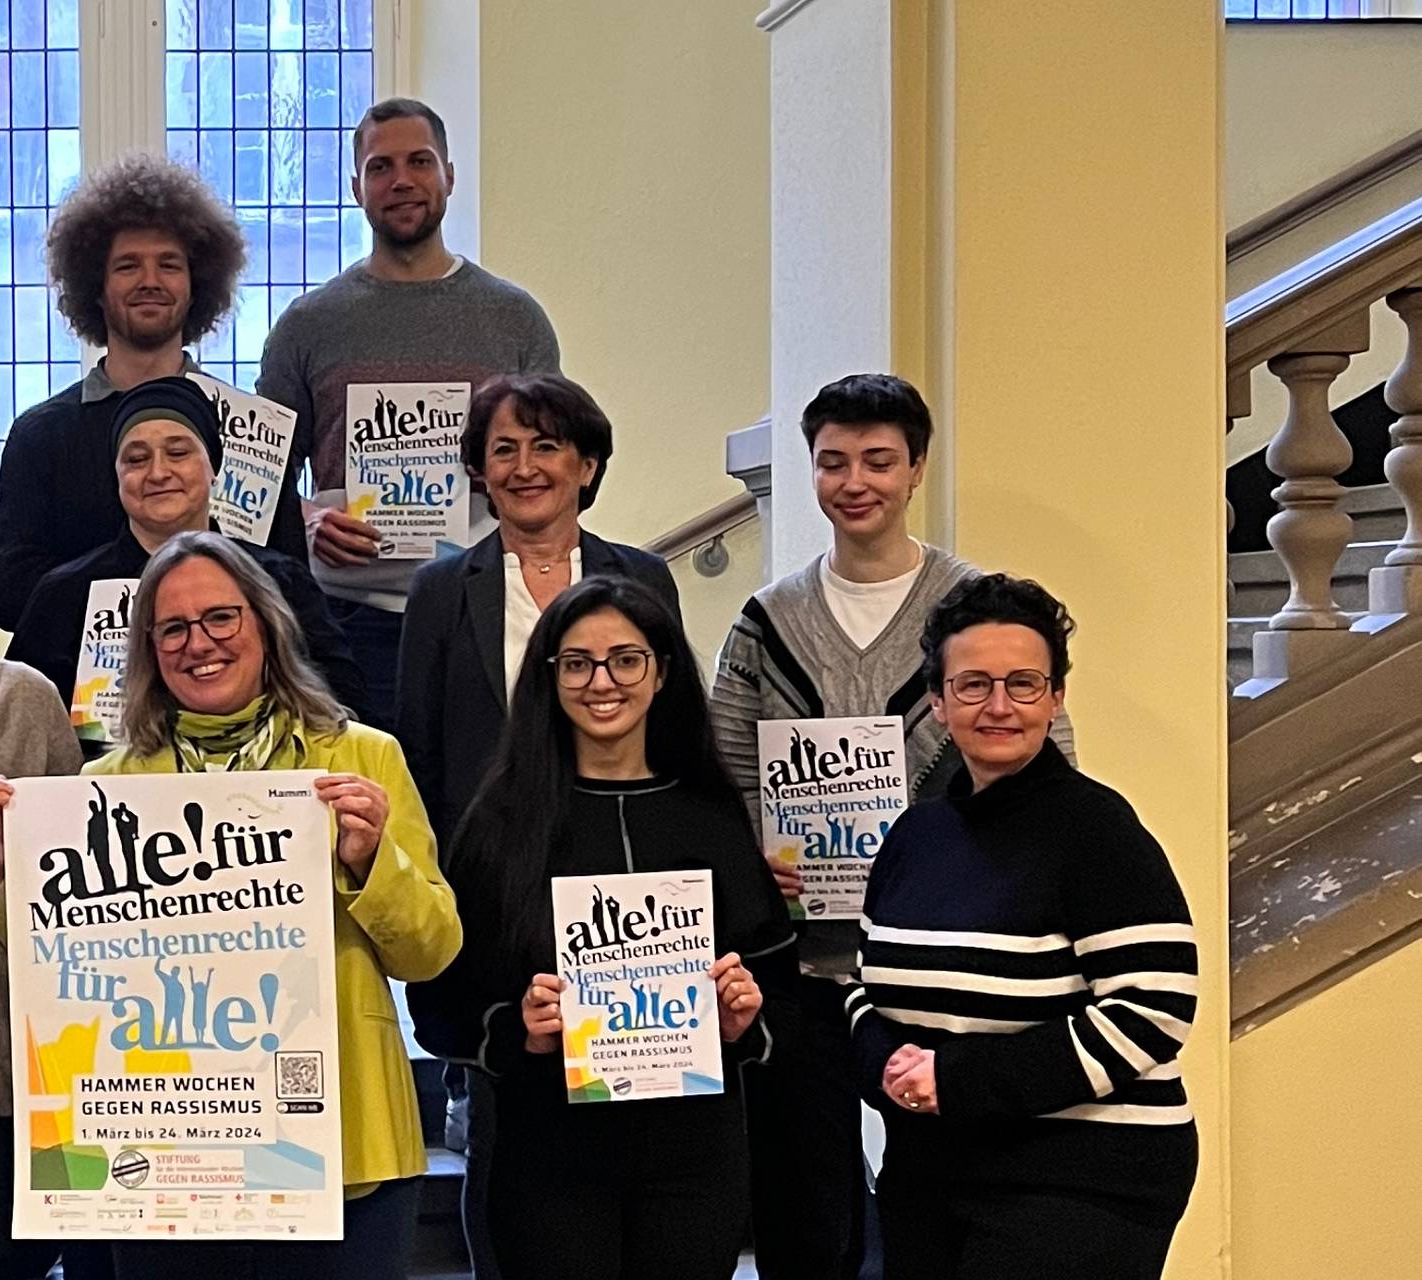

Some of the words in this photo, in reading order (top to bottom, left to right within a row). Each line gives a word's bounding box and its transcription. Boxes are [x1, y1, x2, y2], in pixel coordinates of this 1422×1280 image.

[354, 389, 428, 441] alle!
[428, 408, 463, 429] für
[257, 421, 286, 448] für
[350, 433, 460, 454] Menschenrecht
[350, 452, 460, 469] Menschenrecht
[359, 467, 389, 485] für
[380, 467, 454, 507] alle!
[767, 726, 855, 787] alle!
[855, 747, 895, 772] für
[763, 775, 901, 799] Menschenrechte
[764, 796, 903, 817] Menschenrechte
[778, 814, 812, 835] für
[39, 780, 215, 904] alle!
[212, 821, 293, 869] für
[30, 877, 305, 932] Menschenrechte
[566, 884, 661, 952] alle!
[661, 905, 704, 931] für
[31, 921, 306, 964] Menschenrechte
[561, 935, 710, 967] Menschenrechte
[564, 959, 711, 986] Menschenrechte
[57, 959, 127, 1000] für
[110, 955, 280, 1053] alle!
[578, 981, 616, 1006] für
[608, 981, 699, 1031] alle!
[592, 1036, 639, 1046] HAMMER
[643, 1033, 688, 1043] WOCHEN
[593, 1050, 627, 1059] GEGEN
[631, 1046, 692, 1056] RASSISMUS
[81, 1078, 166, 1092] HAMMER
[173, 1077, 255, 1091] WOCHEN
[82, 1101, 143, 1115] GEGEN
[151, 1100, 262, 1114] RASSISMUS
[82, 1129, 91, 1138] 1.
[97, 1128, 130, 1139] März
[136, 1128, 154, 1138] bis
[160, 1128, 181, 1138] 24.
[187, 1128, 220, 1138] März
[228, 1127, 262, 1138] 2024
[156, 1155, 201, 1164] STIFTUNG
[156, 1175, 188, 1183] GEGEN
[191, 1174, 244, 1183] RASSISMUS
